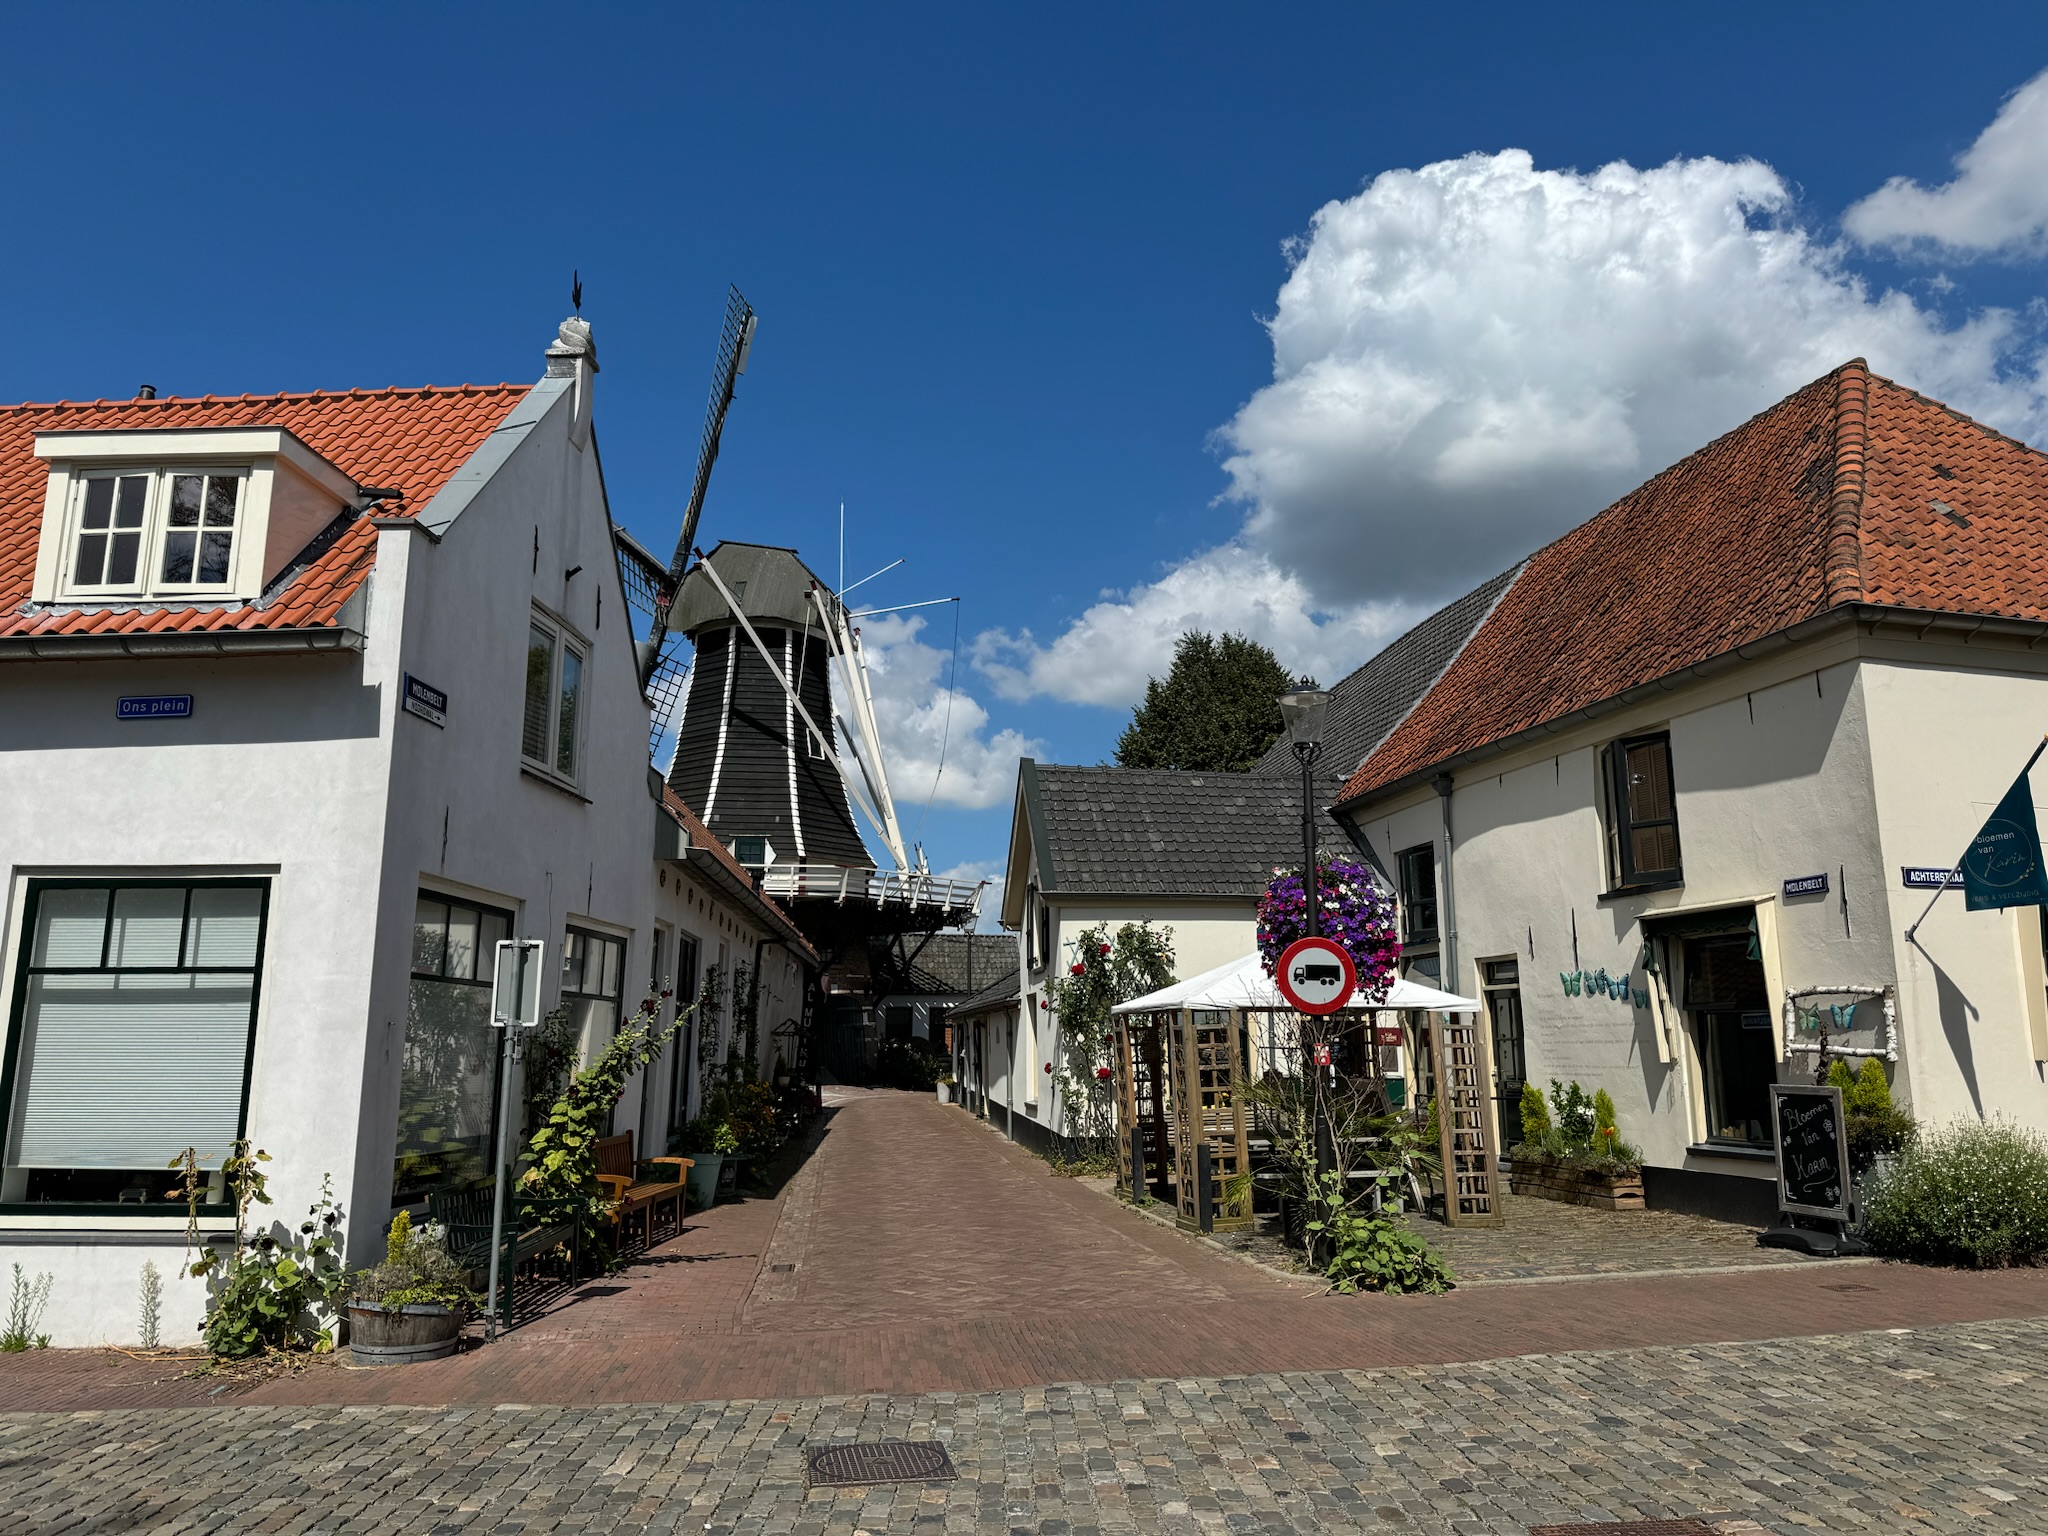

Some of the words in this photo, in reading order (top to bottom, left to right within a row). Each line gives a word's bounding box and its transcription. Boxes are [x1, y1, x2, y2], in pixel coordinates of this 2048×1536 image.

[412, 683, 443, 708] MOLENBELT
[122, 701, 147, 712] Ons
[151, 700, 185, 713] plein
[1976, 831, 2015, 844] bloemen
[1977, 846, 1994, 854] van
[1984, 848, 2028, 878] Karin
[1785, 878, 1823, 893] MOLENBELT
[1998, 889, 2040, 900] VEELZIJDIG
[1783, 1103, 1828, 1131] Bloemen
